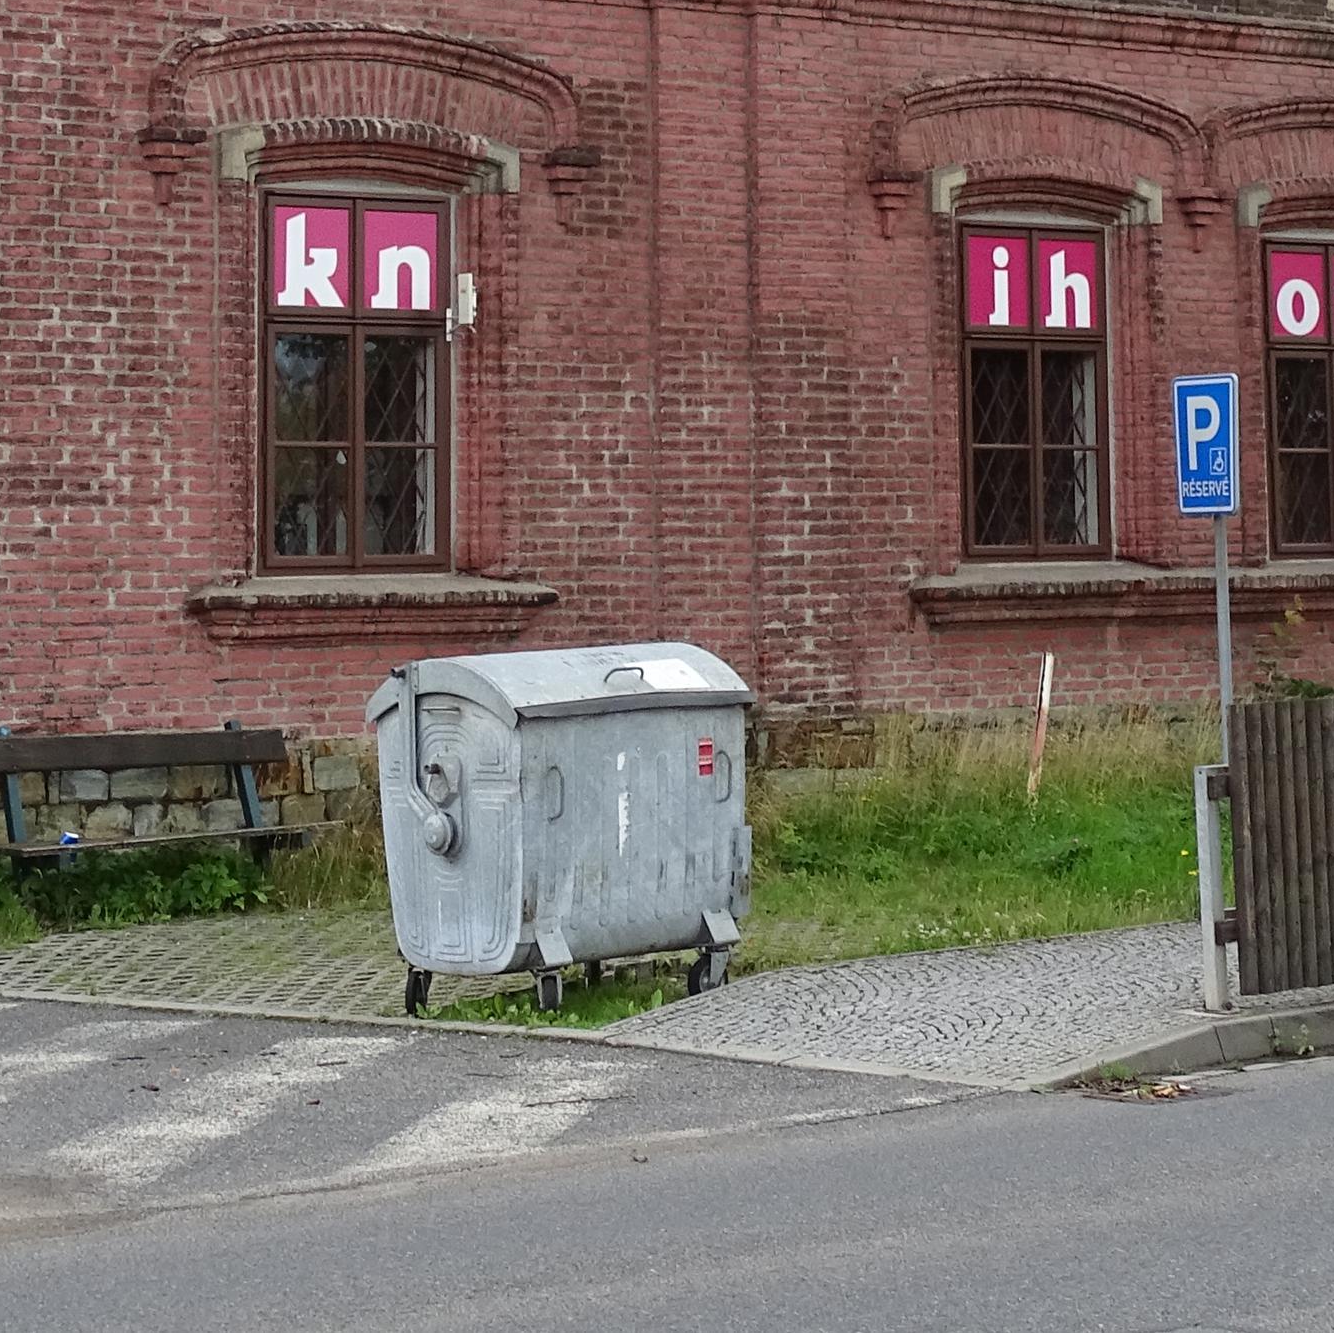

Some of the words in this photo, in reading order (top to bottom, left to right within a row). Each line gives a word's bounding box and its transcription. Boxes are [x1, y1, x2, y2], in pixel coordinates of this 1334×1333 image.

[277, 212, 431, 310] kn
[988, 246, 1091, 328] ih
[1186, 395, 1221, 471] P
[1182, 476, 1230, 498] RÉSERVÉ
